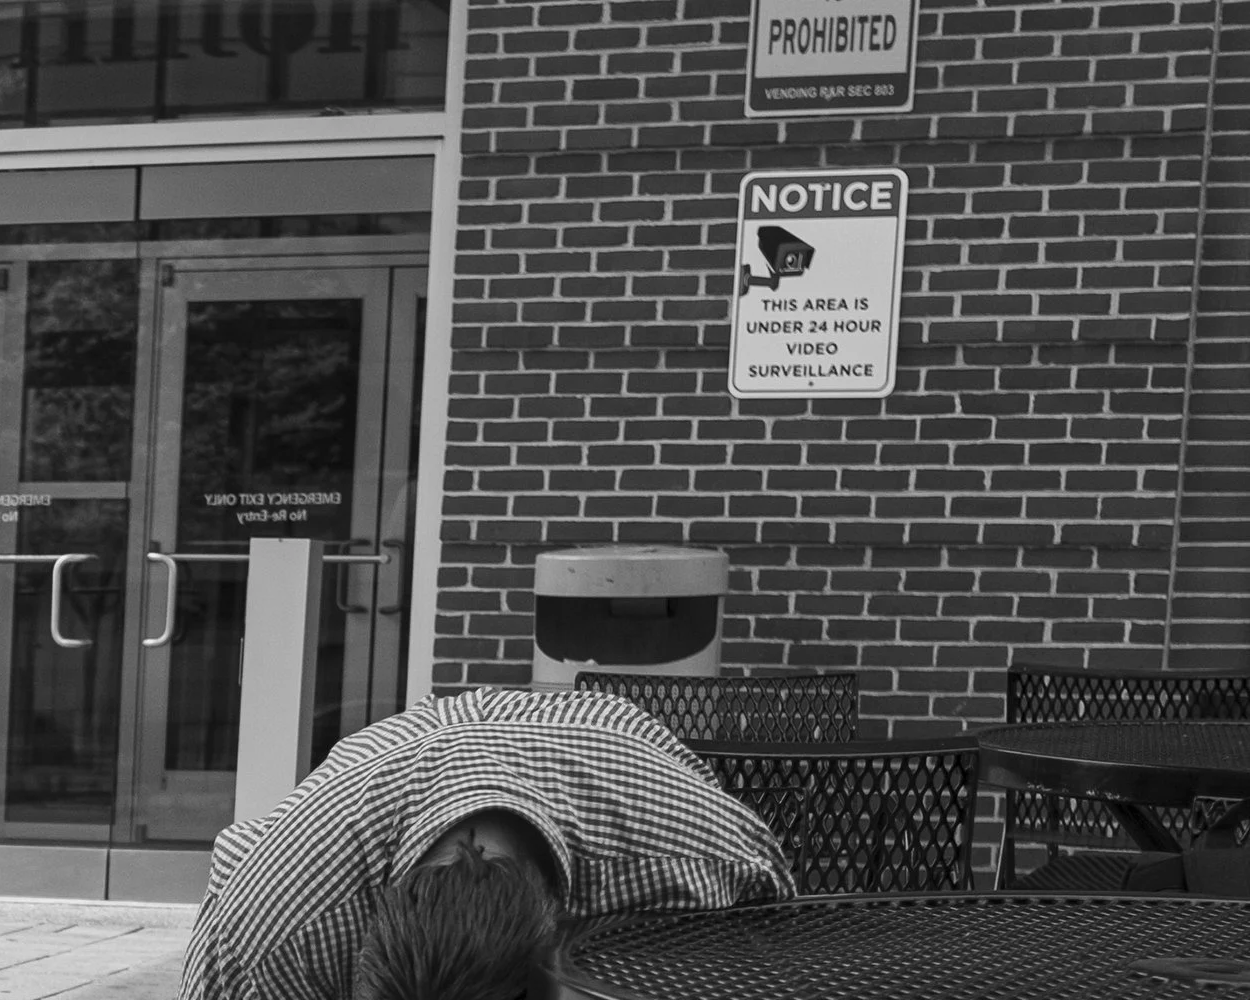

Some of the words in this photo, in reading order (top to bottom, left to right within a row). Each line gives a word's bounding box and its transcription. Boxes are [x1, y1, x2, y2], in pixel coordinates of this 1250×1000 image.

[768, 14, 897, 55] PROHIBITED
[765, 86, 818, 100] VENDING
[848, 84, 872, 98] SEC
[751, 180, 894, 213] NOTICE
[761, 299, 798, 312] THIS
[803, 298, 848, 311] AREA
[854, 298, 869, 311] IS
[746, 321, 803, 334] UNDER
[808, 320, 828, 333] 24
[834, 320, 882, 333] HOUR
[786, 342, 839, 355] VIDEO
[748, 363, 874, 378] SURVEILLANCE
